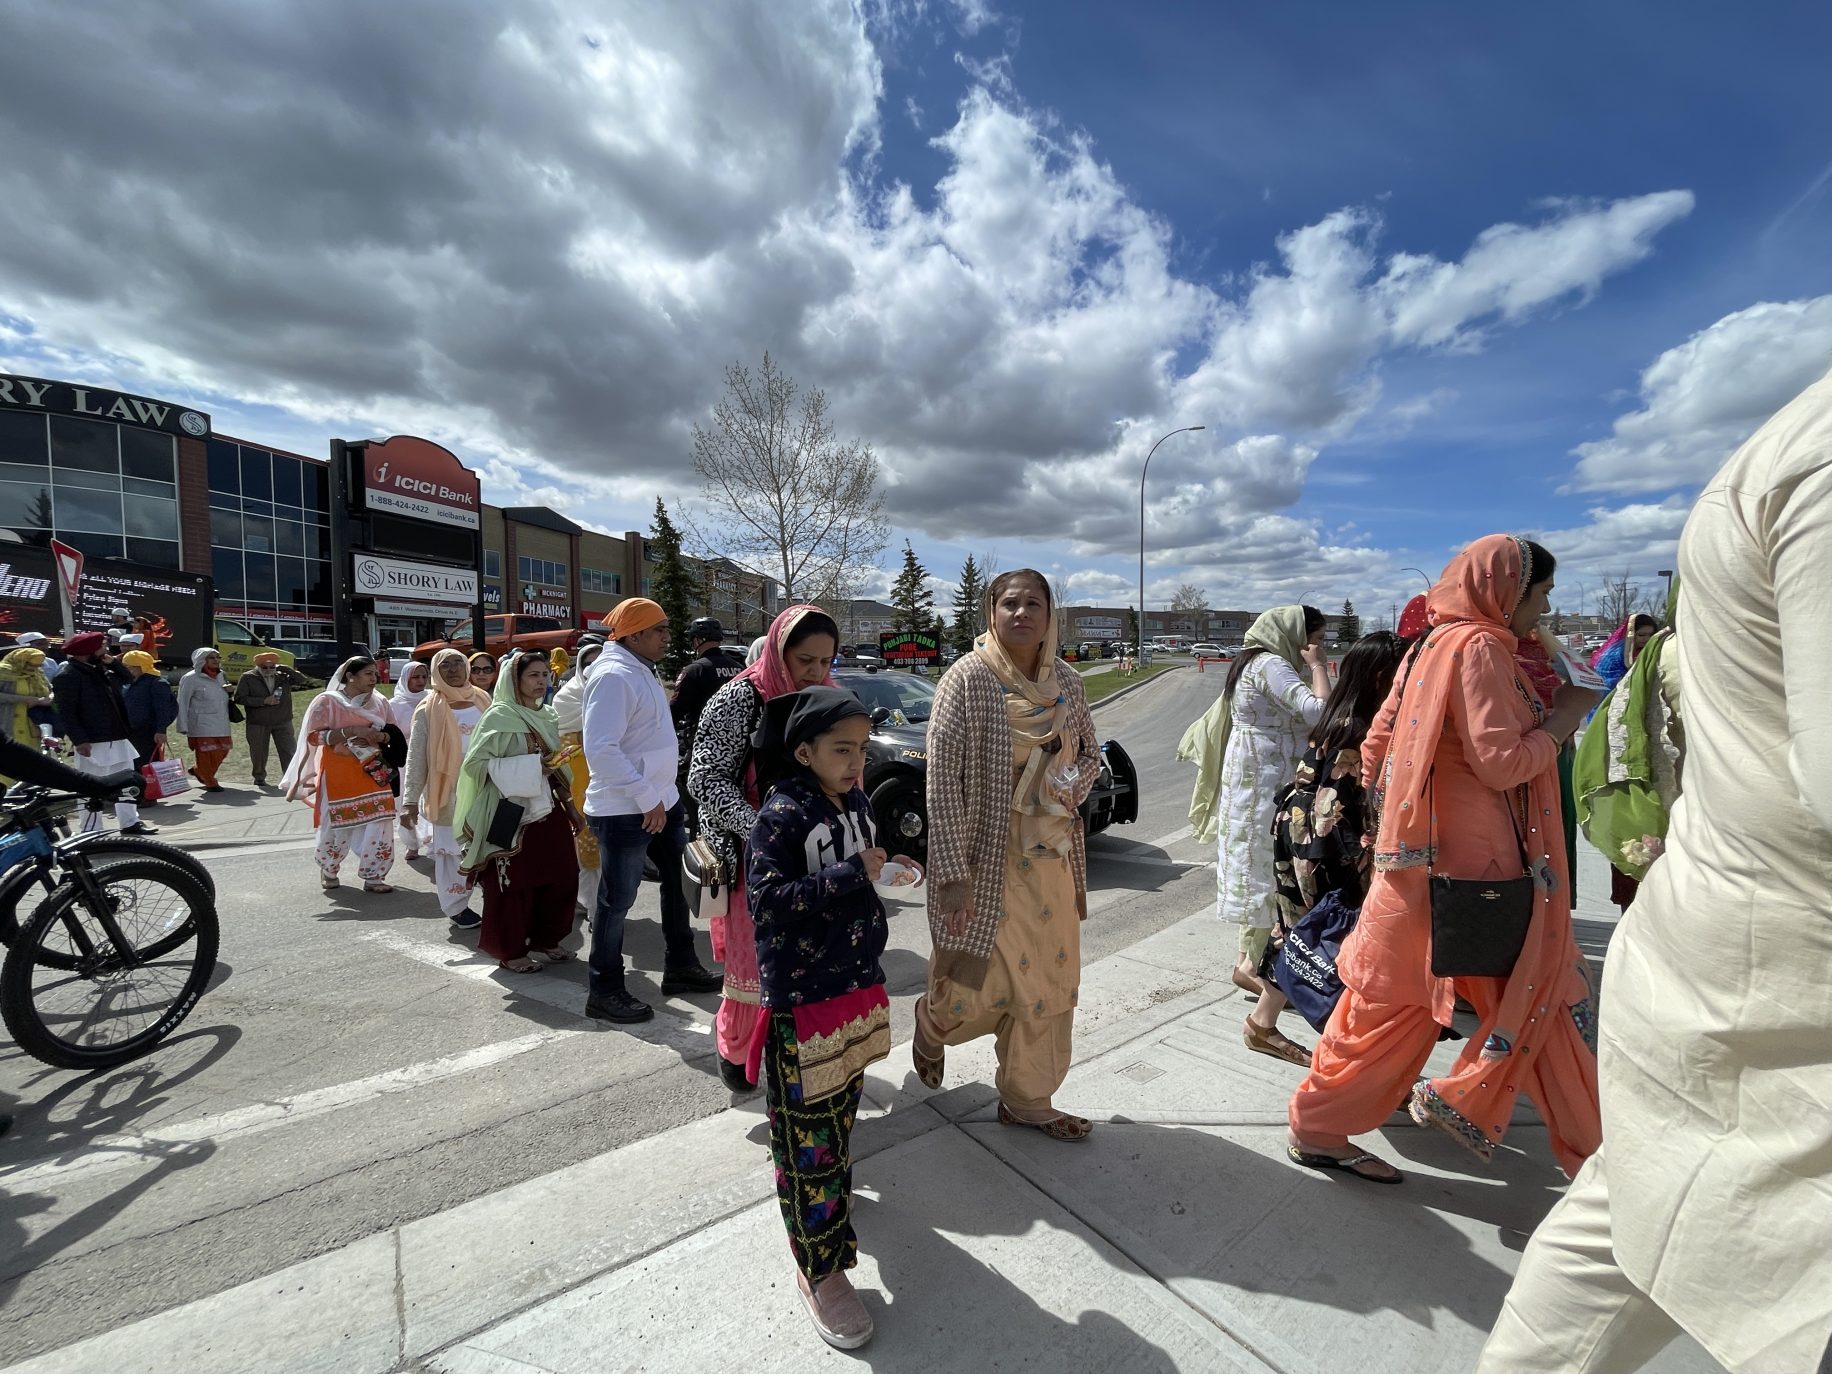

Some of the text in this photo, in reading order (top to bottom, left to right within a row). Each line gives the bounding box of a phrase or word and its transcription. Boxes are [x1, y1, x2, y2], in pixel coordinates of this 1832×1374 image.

[72, 387, 171, 427] LAW
[394, 474, 437, 496] ICICI
[438, 485, 473, 505] Bank
[370, 494, 476, 524] 1-888-424-2422 icicibank.ca
[106, 576, 131, 586] YOUR
[387, 571, 475, 592] SHORY LAW
[483, 590, 500, 603] vels
[541, 589, 567, 598] MCKNIGHT
[523, 601, 571, 618] PHARMACY
[883, 633, 936, 651] PUNJABI TADKA
[902, 750, 928, 760] POLI
[1289, 930, 1313, 956] CICI
[160, 991, 197, 1034] MAXXIS
